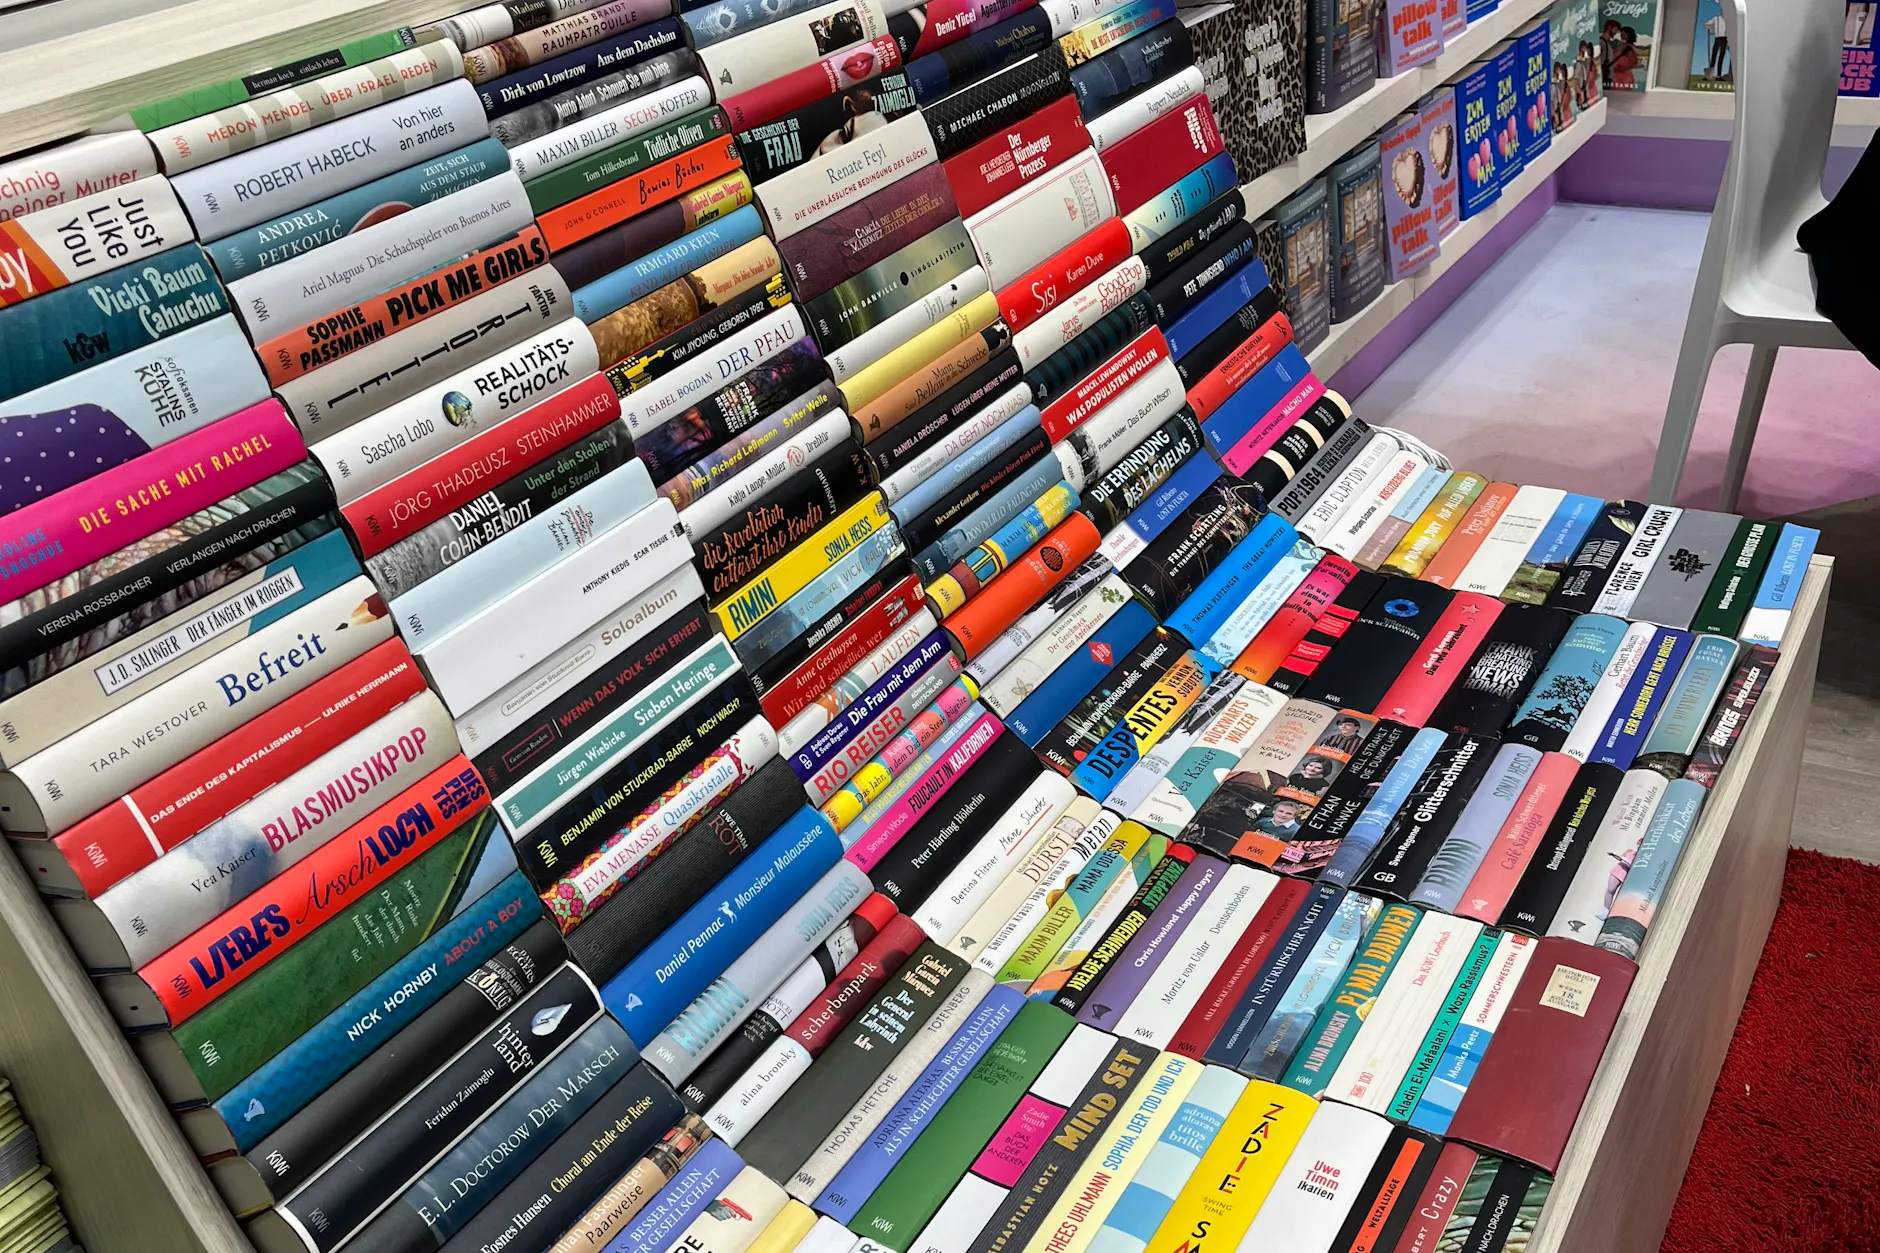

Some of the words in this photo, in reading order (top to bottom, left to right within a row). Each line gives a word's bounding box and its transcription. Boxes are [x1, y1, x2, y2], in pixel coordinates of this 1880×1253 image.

[542, 11, 638, 54] RAUMPATROUILLE
[1603, 1, 1648, 18] Strings
[500, 85, 527, 104] Dirk
[527, 78, 544, 94] von
[545, 62, 586, 86] Lowtzow
[597, 48, 616, 67] Aus
[616, 42, 635, 60] dem
[635, 30, 676, 54] Dachsbau
[207, 118, 257, 143] MERON
[262, 101, 315, 125] MENDEL
[321, 87, 353, 105] ÜBER
[357, 73, 398, 94] ISRAEL
[401, 60, 437, 80] REDEN
[392, 109, 417, 130] Von
[419, 105, 443, 122] hier
[950, 109, 985, 134] MICHAEL
[987, 93, 1018, 116] CHABON
[1465, 97, 1484, 124] ZUM
[400, 135, 416, 151] an
[417, 122, 455, 143] anders
[536, 135, 580, 165] MAXIM
[580, 121, 619, 149] BILLER
[624, 108, 658, 130] SECHS
[659, 89, 699, 115] KOFFER
[1465, 114, 1491, 145] ERSTEN
[234, 163, 305, 202] ROBERT
[307, 136, 377, 175] HABECK
[794, 209, 806, 221] DIE
[806, 177, 857, 216] UNERLÄSSLICHE
[855, 161, 893, 191] BEDINGUNG
[893, 155, 905, 171] DES
[905, 147, 927, 167] GLÜCKS
[826, 158, 863, 184] Renate
[863, 143, 887, 170] Feyl
[1477, 159, 1496, 187] MAL
[258, 208, 329, 244] ANDREA
[258, 219, 343, 266] PETKOVIĆ
[1392, 207, 1432, 247] pillow
[1402, 230, 1427, 254] talk
[88, 278, 148, 316] Vicki
[147, 261, 206, 297] Baum
[386, 280, 446, 327] PICK
[451, 264, 484, 299] ME
[484, 237, 545, 284] GIRLS
[838, 304, 859, 322] JOHN
[860, 282, 898, 308] BANVILLE
[910, 241, 965, 278] SINGULARITÄTEN
[1032, 274, 1056, 313] Sisi
[1066, 264, 1086, 283] Karen
[1086, 251, 1104, 271] Duve
[139, 291, 221, 338] Cahuchu
[307, 307, 365, 345] SOPHIE
[300, 319, 385, 371] PASSMANN
[474, 338, 574, 396] REALITÄTS-
[498, 363, 570, 410] SCHOCK
[1066, 405, 1087, 425] WAS
[1086, 373, 1129, 411] POPULISTEN
[1127, 349, 1158, 381] WOLLEN
[1077, 381, 1099, 400] MARCEL
[1098, 349, 1137, 385] LEWANDOWSKY
[361, 431, 406, 464] Sascha
[406, 417, 435, 442] Lobo
[388, 491, 432, 529] JÖRG
[433, 447, 511, 500] THADEUSZ
[517, 392, 613, 456] STEINHAMMER
[79, 507, 111, 534] DIE
[117, 480, 171, 515] SACHE
[175, 463, 206, 487] MIT
[211, 433, 272, 471] RACHEL
[1091, 483, 1110, 503] DIE
[1108, 430, 1170, 489] ERFINDUNG
[1124, 485, 1144, 507] DES
[1141, 437, 1191, 492] LÄCHELNS
[1632, 537, 1650, 559] GIRL
[1648, 509, 1672, 540] CRUSH
[729, 580, 778, 633] RIMINI
[824, 531, 850, 563] SONJA
[848, 517, 872, 545] HEISS
[1605, 561, 1634, 597] FLORENCE
[1624, 570, 1643, 591] GIVEN
[1653, 653, 1668, 674] NACH
[1662, 635, 1677, 661] BRÜSSEL
[322, 694, 357, 718] ULRIKE
[355, 664, 408, 698] HERRMANN
[848, 709, 868, 725] Die
[865, 687, 886, 710] Frau
[884, 676, 903, 695] mit
[902, 658, 922, 682] dem
[919, 641, 941, 665] Arm
[1631, 679, 1653, 725] SONNEBORN
[1643, 667, 1659, 687] GEHT
[90, 747, 130, 773] TARA
[133, 701, 208, 748] WESTOVER
[216, 632, 326, 707] Befreit
[556, 755, 587, 786] Jürgen
[585, 729, 626, 762] Wiebicke
[634, 690, 674, 727] Sieben
[672, 661, 717, 699] Heringe
[1203, 700, 1249, 745] RÜCKWÄRTS
[1624, 712, 1641, 736] HERR
[1710, 709, 1740, 746] BRINGS
[814, 759, 849, 795] RIO
[846, 706, 908, 762] REISER
[1088, 690, 1178, 779] DESPENTES
[1226, 713, 1258, 743] WALZER
[150, 807, 175, 824] DAS
[176, 787, 205, 809] ENDE
[205, 773, 228, 791] DES
[228, 726, 302, 776] KAPITALISMUS
[262, 726, 427, 854] BLASMUSIKPOP
[1389, 851, 1404, 867] Sven
[1401, 826, 1421, 855] Regener
[1414, 740, 1479, 823] Glitterschnitter
[655, 947, 689, 984] Daniel
[688, 917, 725, 955] Pennac
[734, 868, 776, 910] Monsieur
[773, 824, 823, 872] Malaussène
[1210, 884, 1250, 934] Deutschboden
[1517, 912, 1536, 923] KiWi
[1067, 959, 1102, 991] HELGE
[1098, 910, 1147, 969] SCHNEIDER
[1184, 961, 1199, 984] von
[1191, 940, 1210, 967] Uslar
[346, 1009, 382, 1042] NICK
[384, 963, 439, 1011] HORNBY
[1161, 981, 1186, 1005] Moritz
[1477, 952, 1519, 1023] SOMMERSCHWESTERN
[739, 1081, 764, 1106] alina
[762, 1048, 797, 1084] bronsky
[800, 960, 878, 1041] scherbenpark
[1398, 1082, 1417, 1116] Aladin
[1410, 1029, 1448, 1085] El-Mafaalani
[1448, 990, 1468, 1015] Wozu
[1461, 944, 1491, 995] Rassismus?
[1446, 1047, 1469, 1079] Monika
[1463, 1029, 1479, 1055] Peetz
[1054, 1092, 1117, 1152] MIND
[1102, 1048, 1142, 1089] SET
[1103, 1129, 1140, 1171] SOPHIA,
[1126, 1114, 1146, 1139] DER
[1139, 1094, 1162, 1121] TOD
[1155, 1075, 1177, 1104] UND
[1169, 1059, 1186, 1083] ICH
[417, 1206, 440, 1226] E.
[433, 1195, 456, 1216] L.
[450, 1122, 531, 1197] DOCTOROW
[528, 1098, 562, 1128] DER
[557, 1045, 619, 1101] MARSCH
[1297, 1181, 1334, 1201] Ikarien
[1304, 1170, 1339, 1190] Timm
[1314, 1160, 1341, 1177] Uwe
